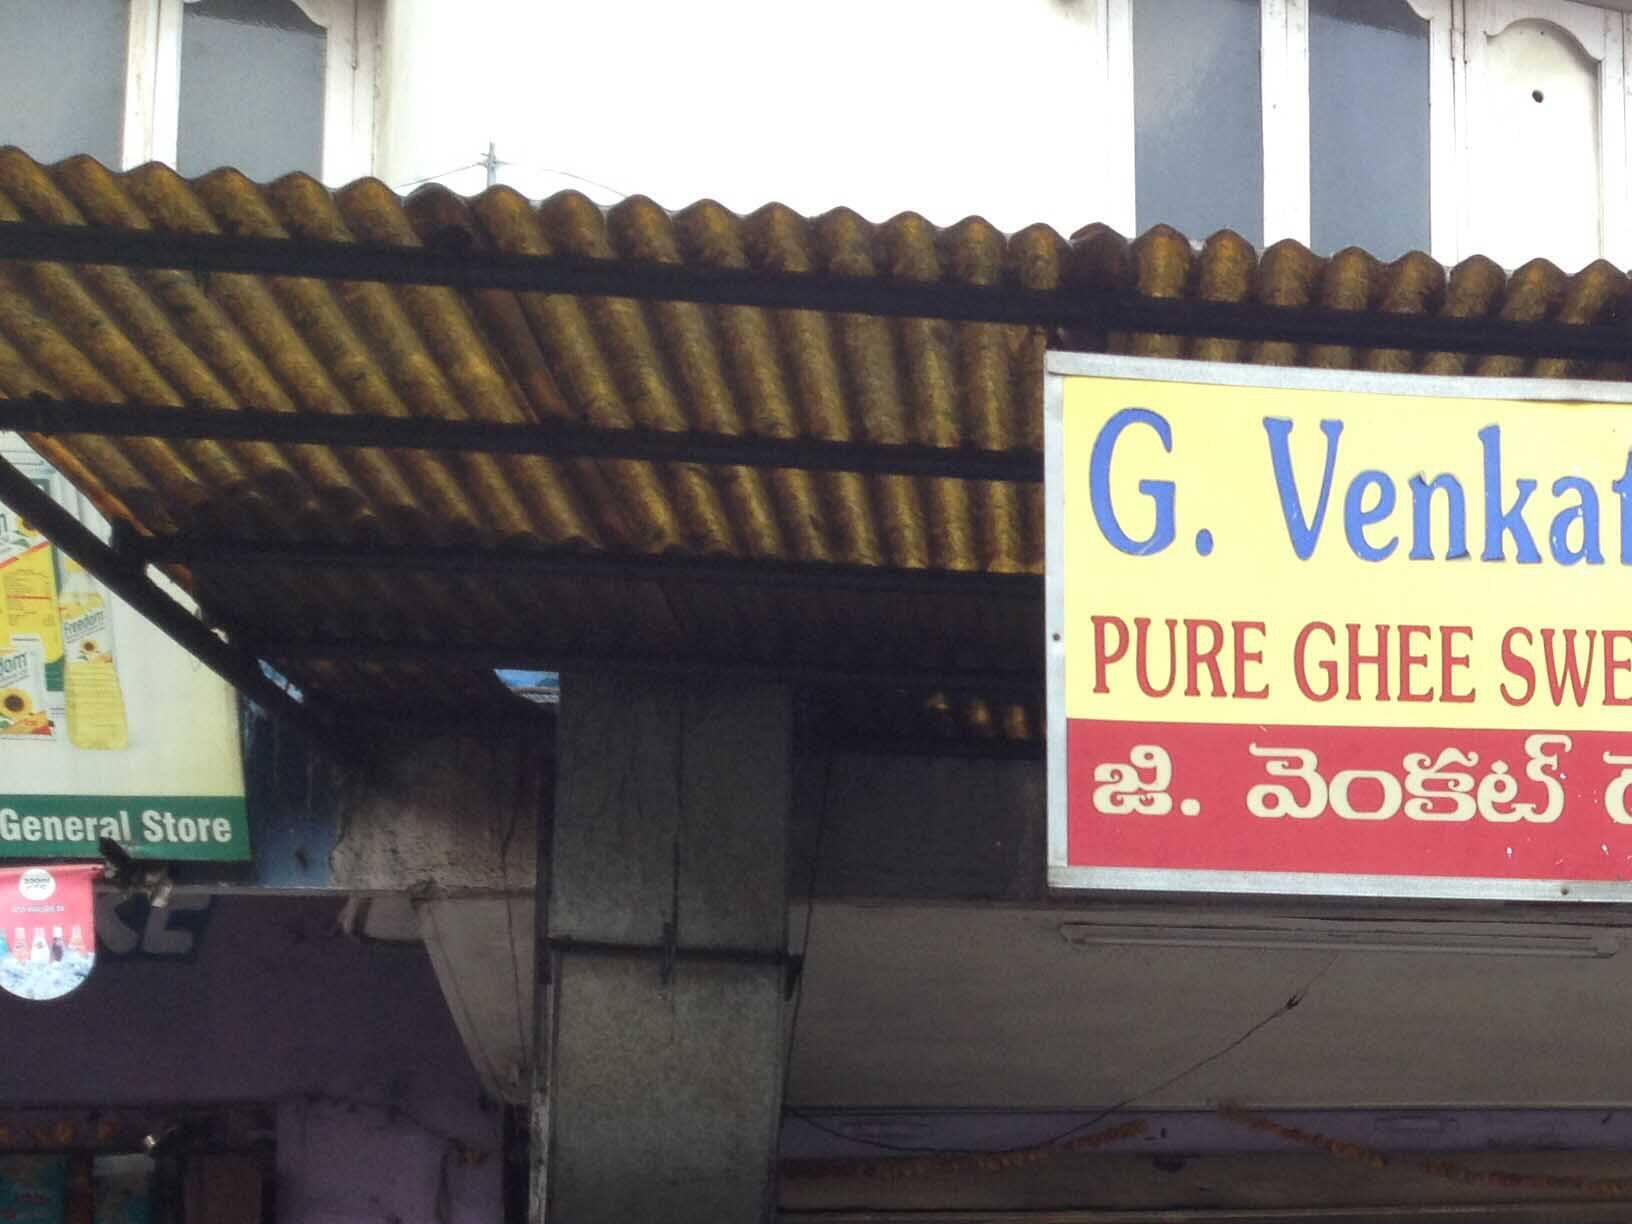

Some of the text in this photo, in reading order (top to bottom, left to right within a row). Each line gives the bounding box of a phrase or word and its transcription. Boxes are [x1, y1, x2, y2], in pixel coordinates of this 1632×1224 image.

[1089, 407, 1214, 557] G.
[1090, 615, 1270, 700] PURE
[1293, 621, 1476, 706] GHEE
[1245, 733, 1572, 823] వెంకట్
[0, 808, 233, 843] General Store
